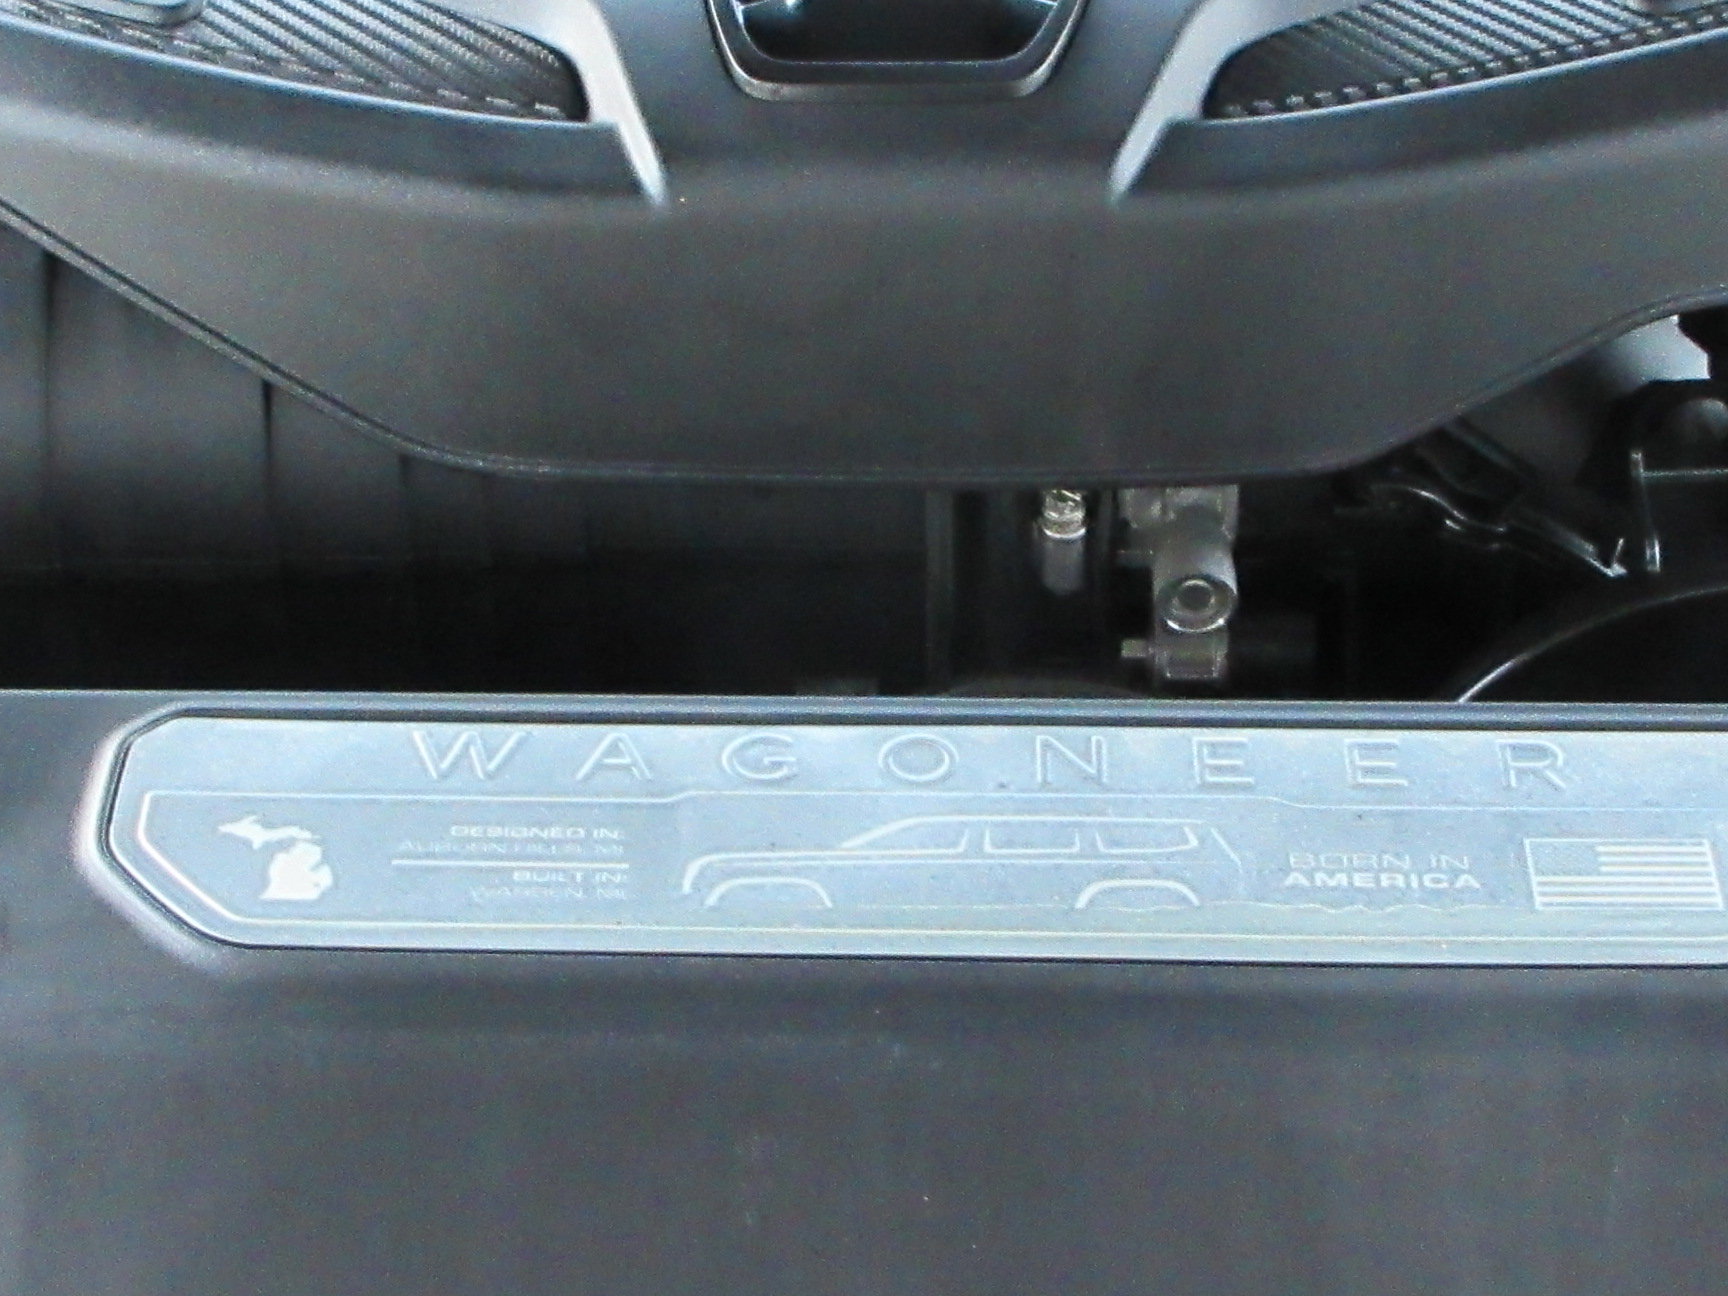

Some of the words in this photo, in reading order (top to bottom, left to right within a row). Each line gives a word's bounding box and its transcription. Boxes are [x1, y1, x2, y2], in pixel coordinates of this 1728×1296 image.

[410, 729, 1570, 791] WAGONEER
[449, 824, 586, 838] DESIGNED
[1288, 852, 1411, 870] BORN
[1428, 853, 1470, 871] IN
[512, 869, 584, 883] BUILT
[1283, 871, 1483, 889] AMERICA
